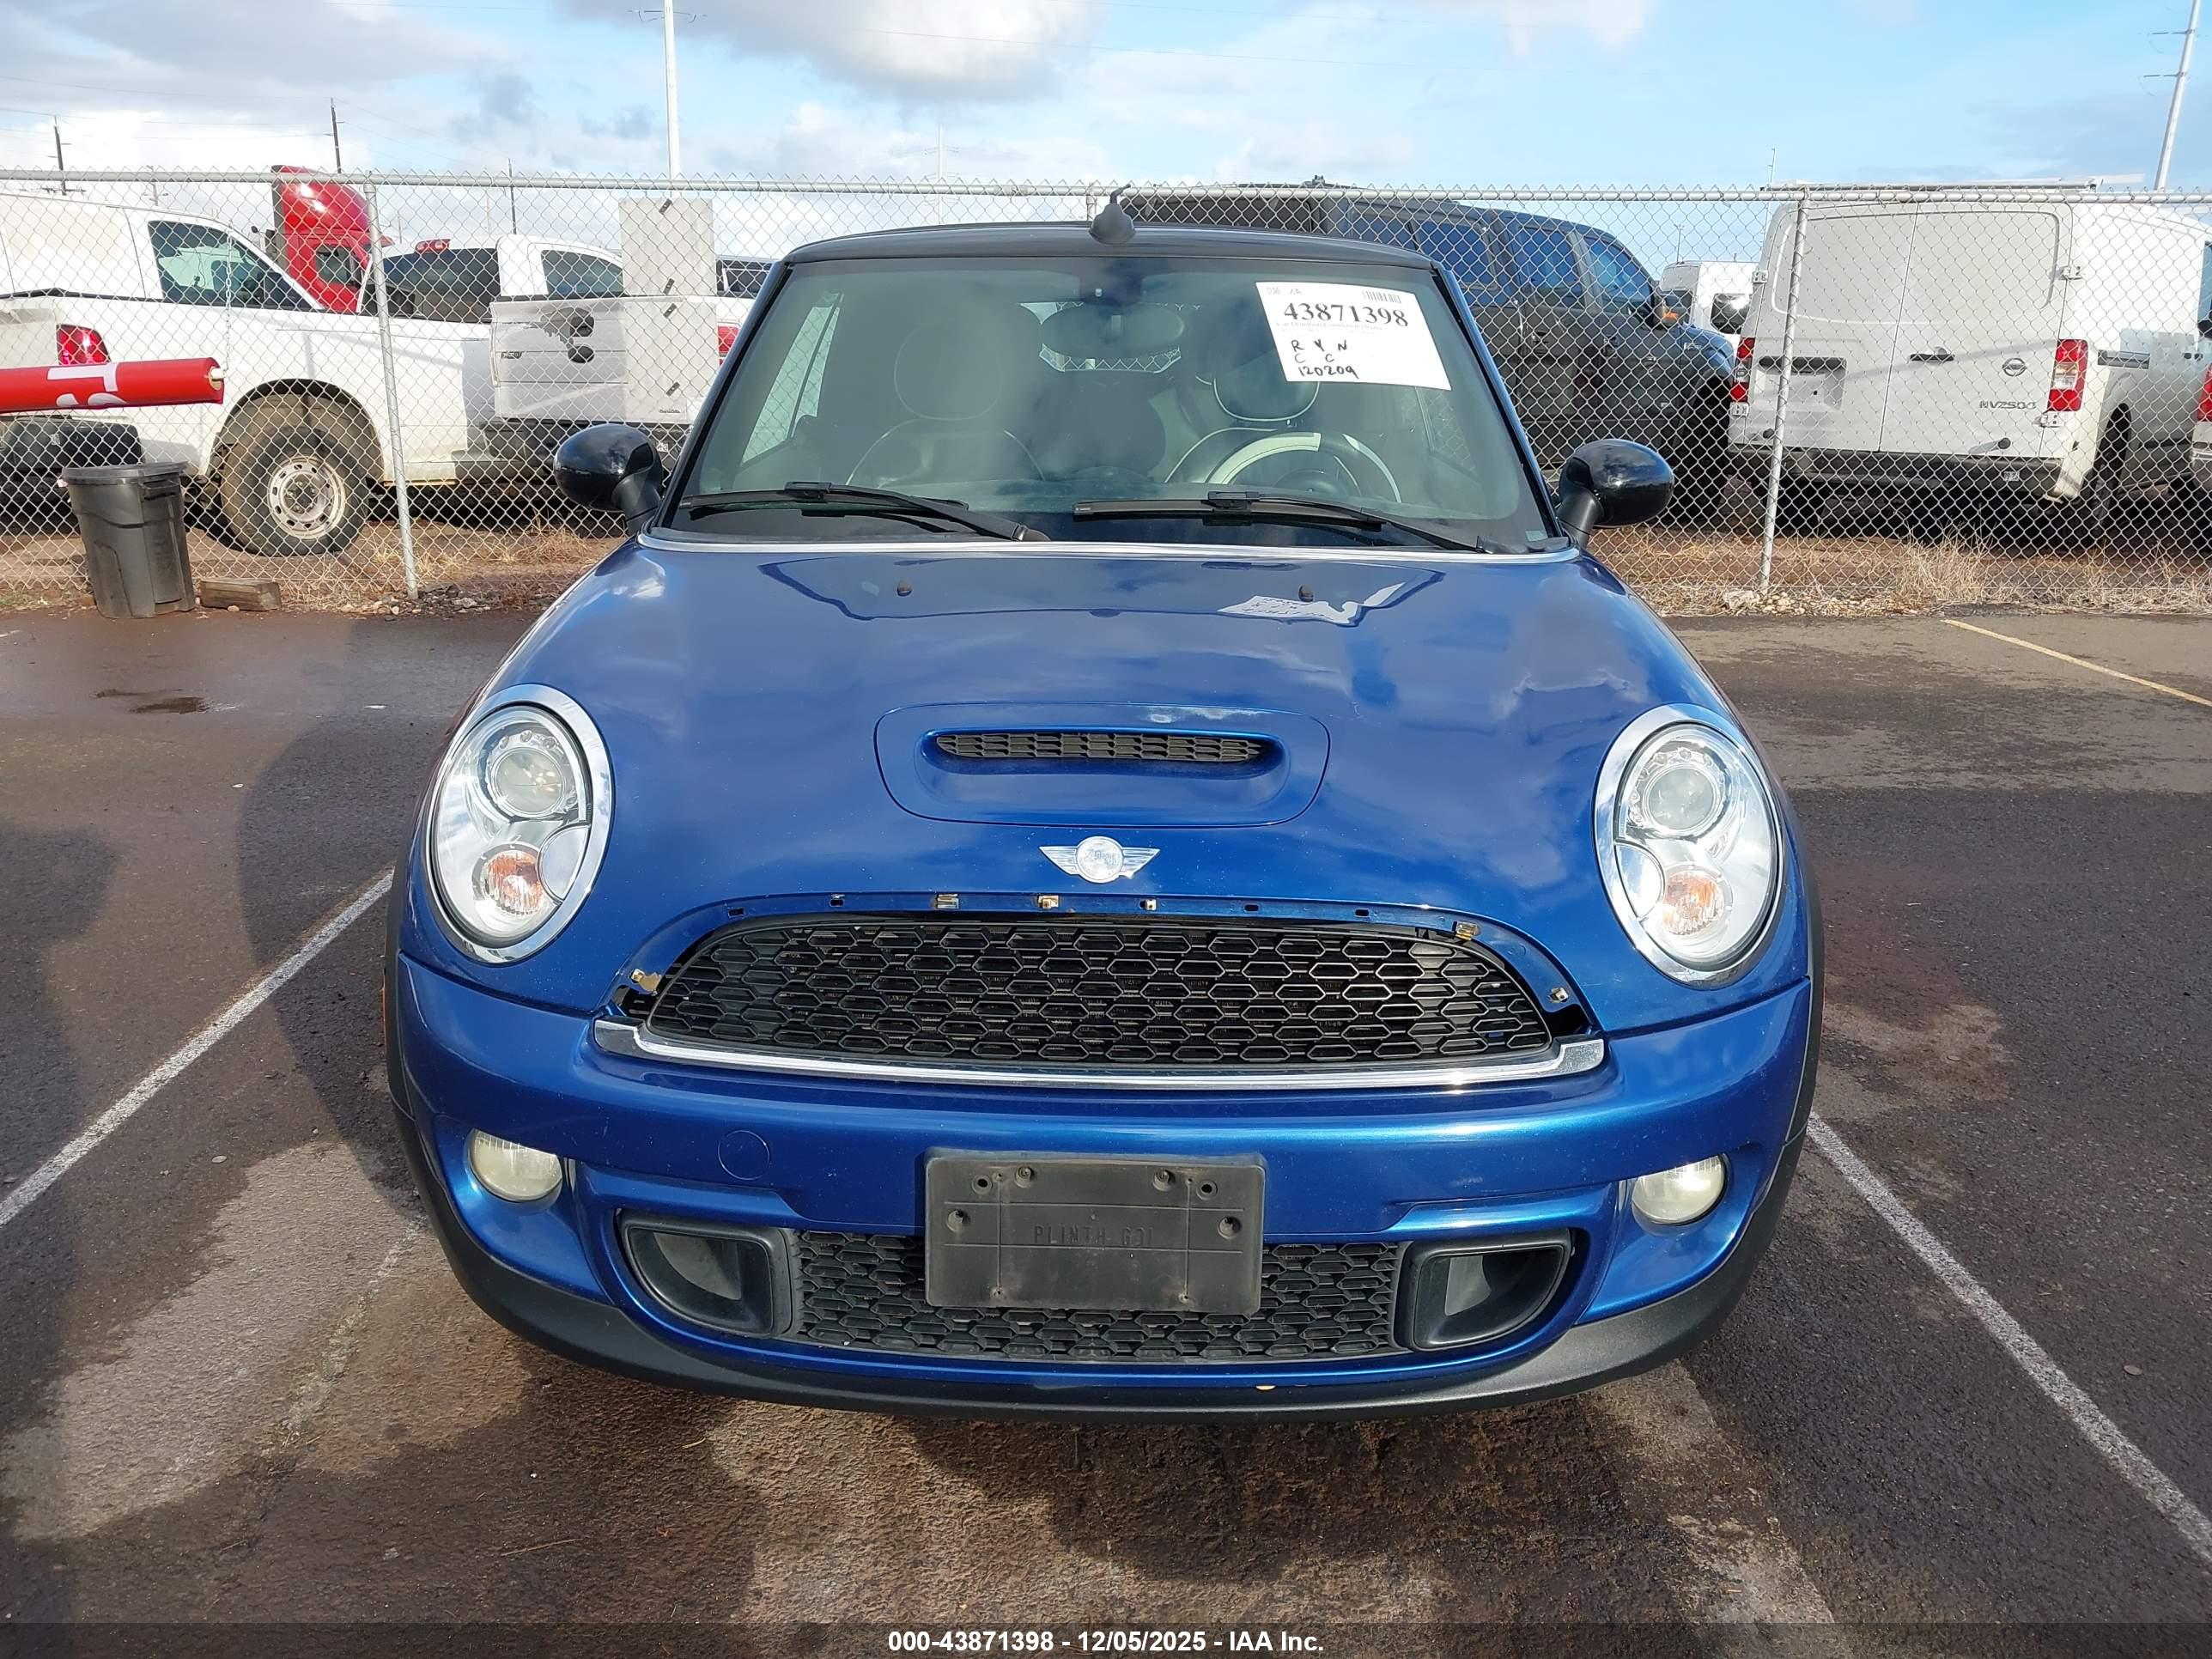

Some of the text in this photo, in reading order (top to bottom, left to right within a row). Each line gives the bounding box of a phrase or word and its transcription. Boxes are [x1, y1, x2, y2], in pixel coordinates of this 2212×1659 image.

[1284, 302, 1408, 327] 43871398
[1291, 339, 1305, 353] R
[1325, 353, 1335, 363] C
[1979, 400, 2036, 410] NV2500
